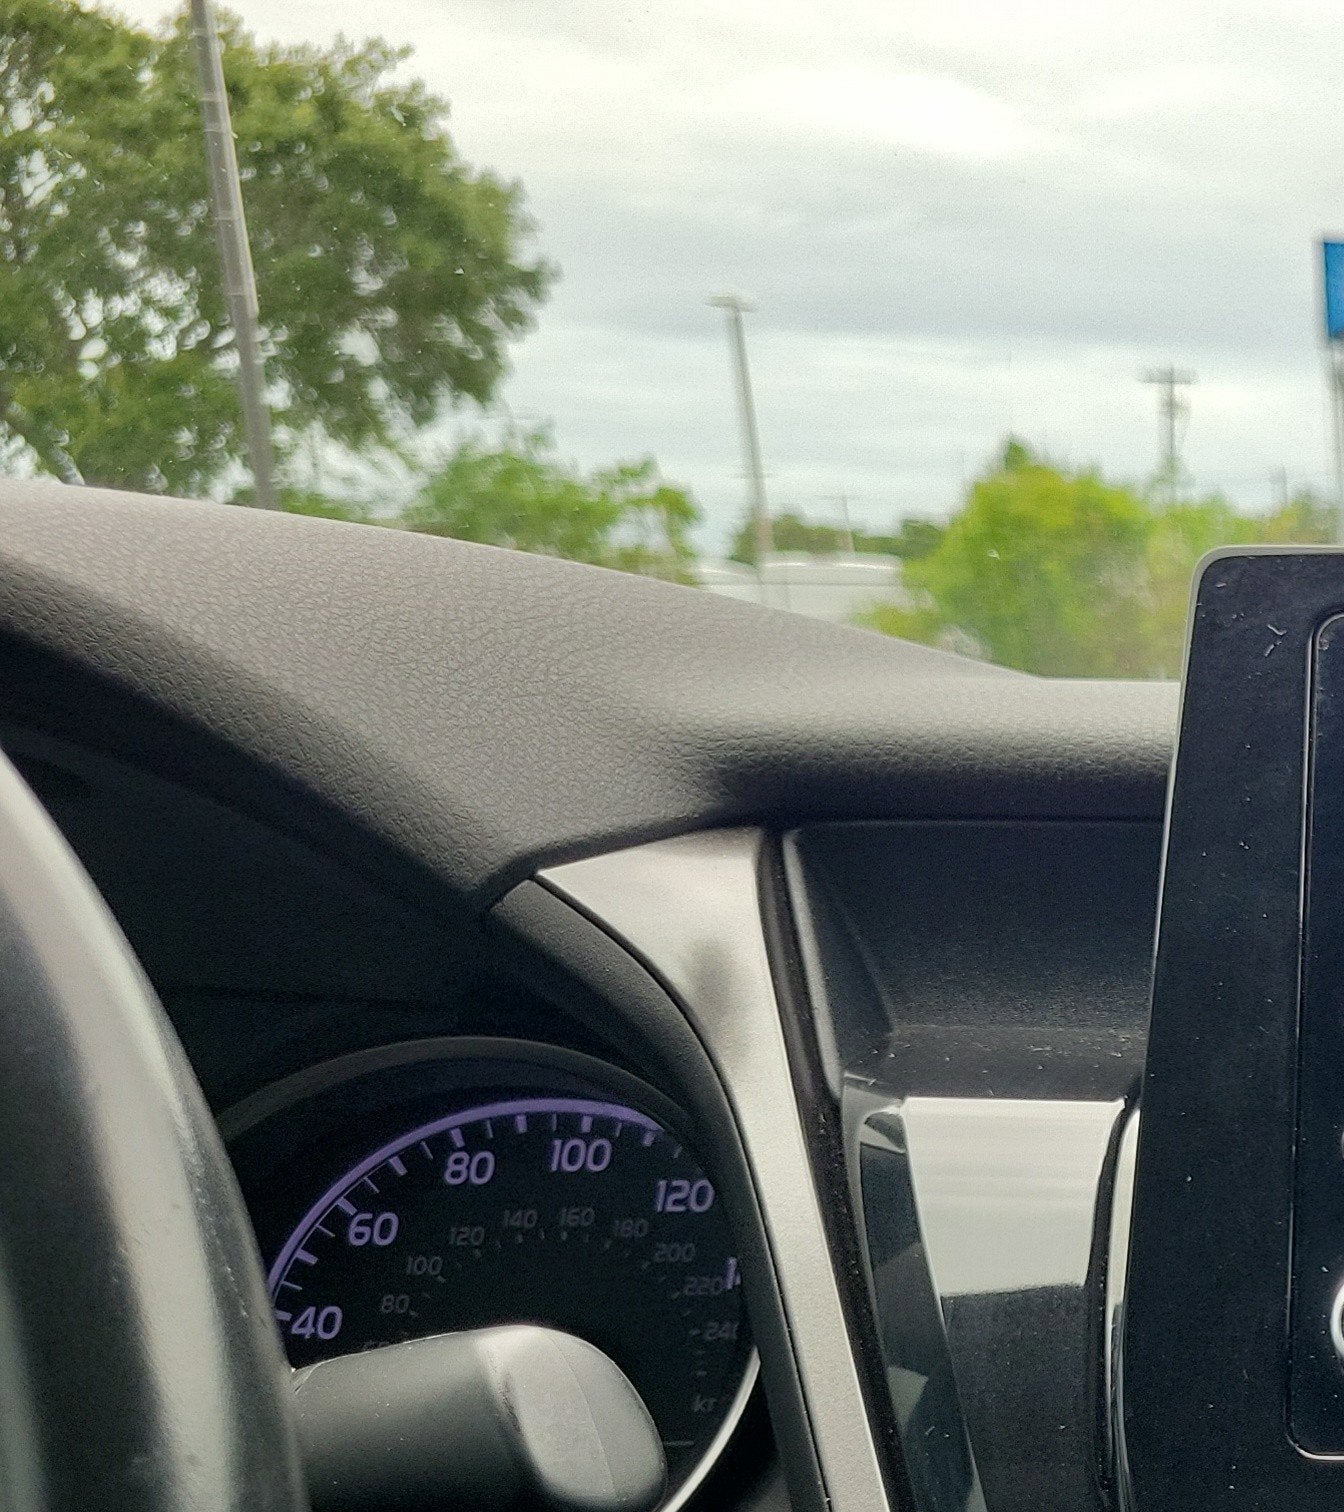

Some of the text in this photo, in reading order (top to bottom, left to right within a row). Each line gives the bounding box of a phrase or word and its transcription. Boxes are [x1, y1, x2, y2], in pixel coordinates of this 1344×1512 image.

[550, 1138, 612, 1173] 100
[444, 1151, 496, 1185] 80
[655, 1179, 715, 1213] 120
[502, 1207, 537, 1230] 140
[559, 1206, 595, 1227] 160
[348, 1212, 399, 1247] 60
[448, 1225, 485, 1246] 120
[614, 1218, 649, 1239] 180
[654, 1242, 696, 1264] 200
[406, 1255, 443, 1277] 100
[380, 1293, 411, 1314] 80
[290, 1305, 343, 1340] 40
